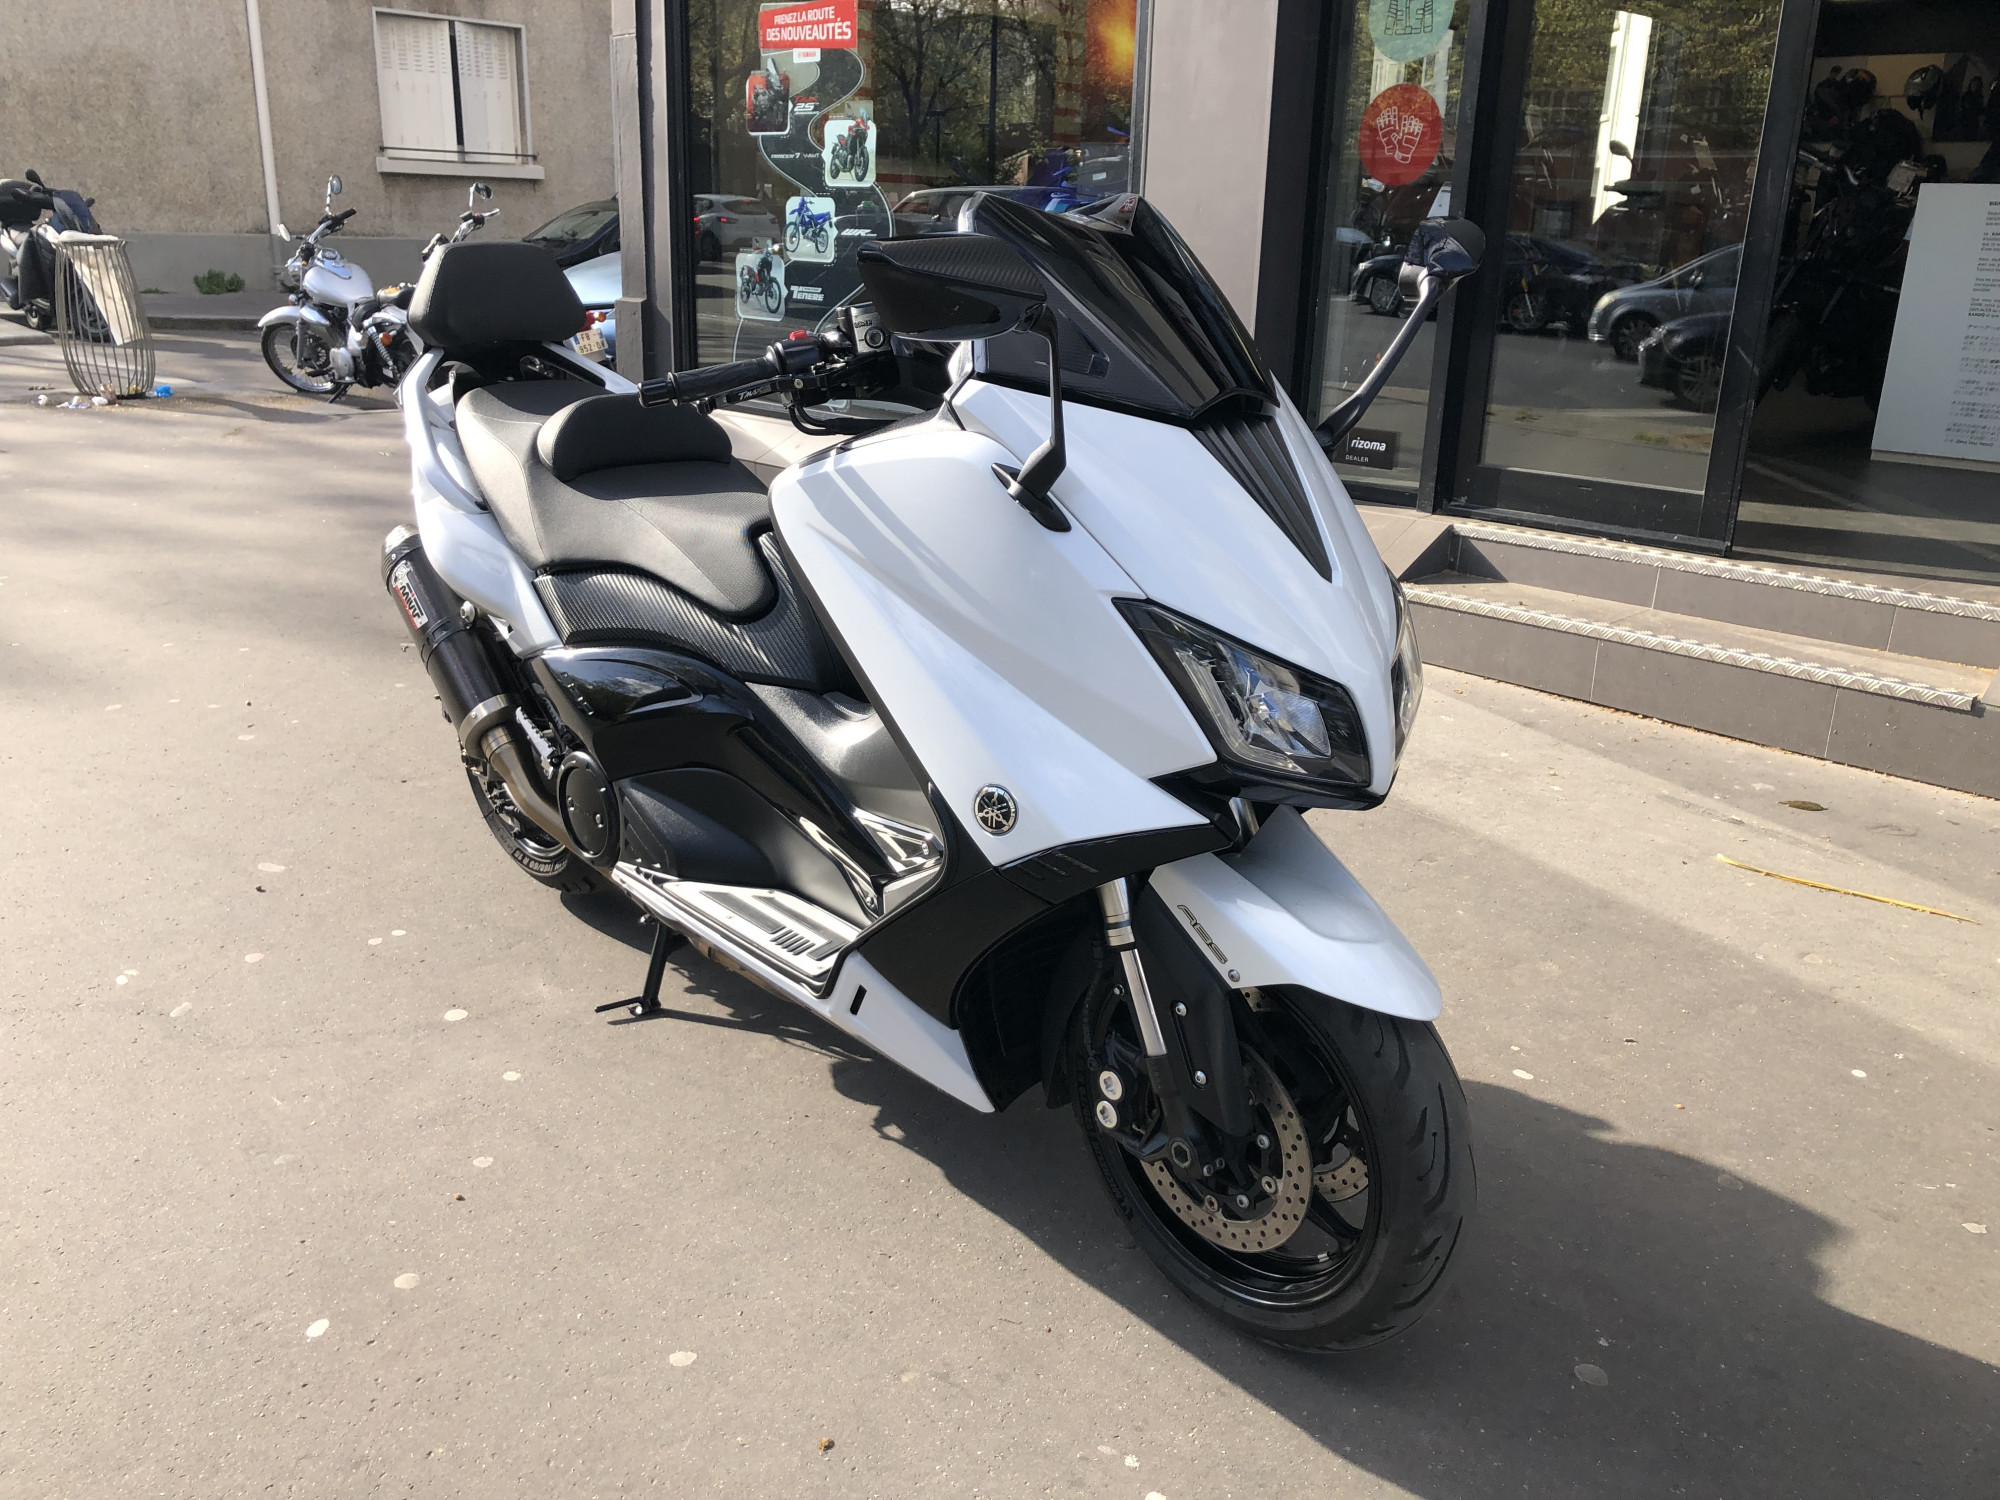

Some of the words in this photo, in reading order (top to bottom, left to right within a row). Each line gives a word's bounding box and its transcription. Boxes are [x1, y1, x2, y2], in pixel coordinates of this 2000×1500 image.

[774, 13, 797, 25] PRENEZ
[798, 11, 807, 22] LA
[808, 6, 836, 20] ROUTE
[766, 27, 780, 41] DES
[781, 17, 852, 40] NOUVEAUTÉS
[1351, 437, 1387, 451] rizoma
[1345, 454, 1369, 463] DEALER
[1177, 904, 1228, 965] ABS
